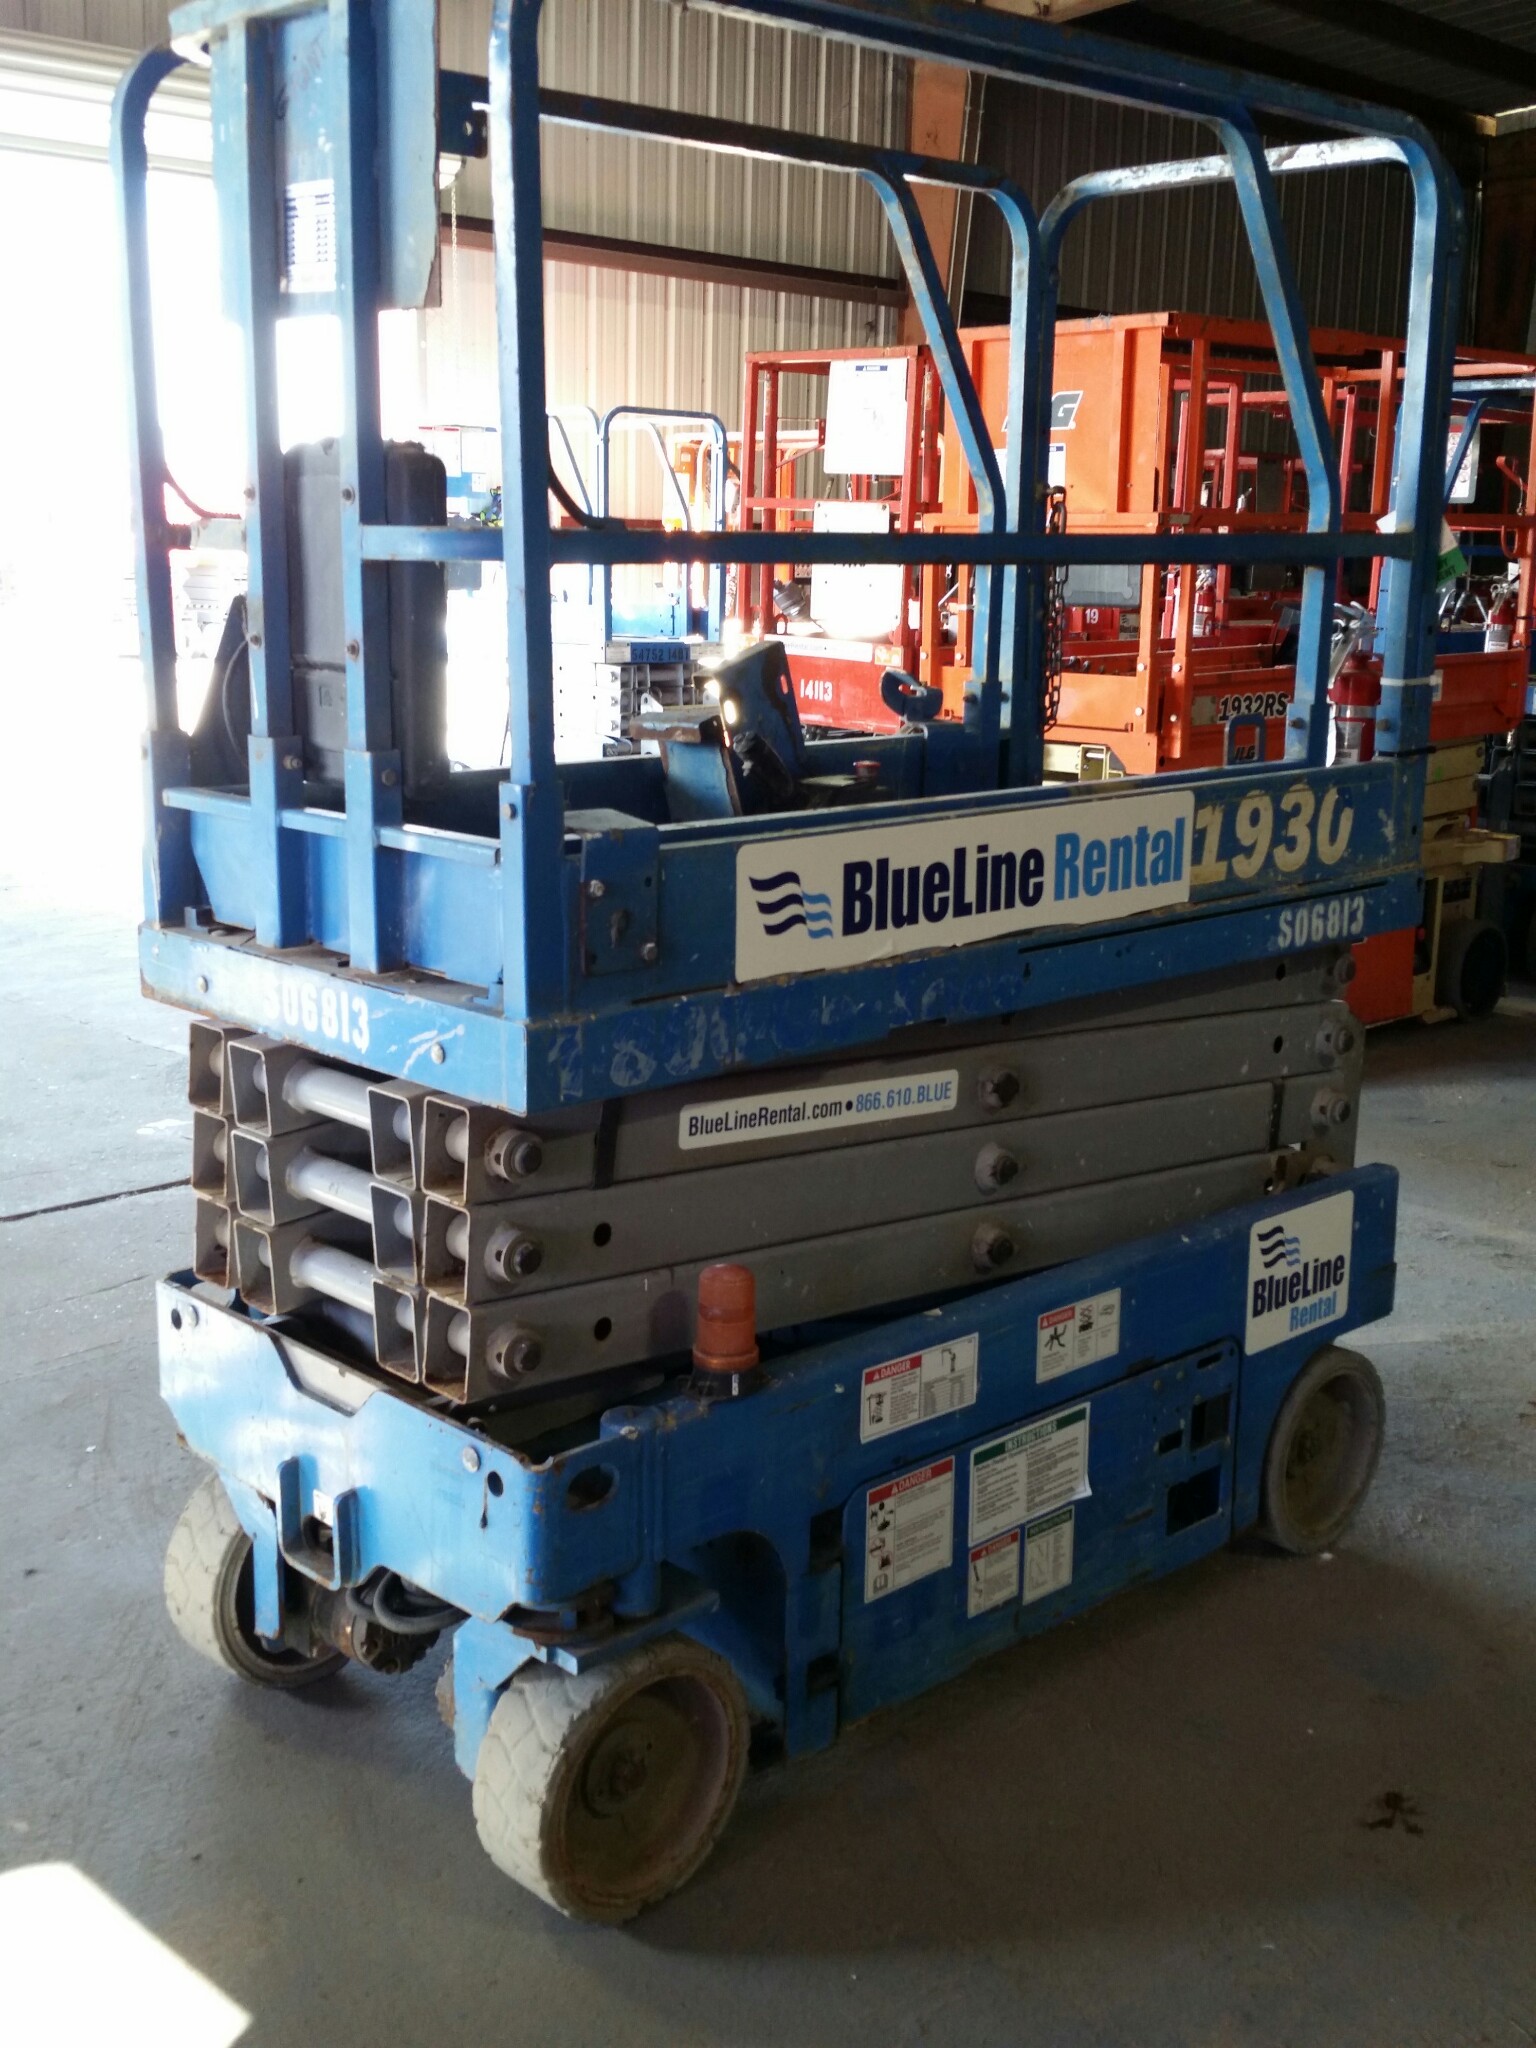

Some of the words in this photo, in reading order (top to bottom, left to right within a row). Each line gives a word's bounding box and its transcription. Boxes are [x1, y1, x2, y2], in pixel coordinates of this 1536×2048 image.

[800, 679, 833, 701] 14113
[1218, 691, 1290, 722] 1932RS
[1189, 783, 1355, 886] 1930
[842, 844, 1045, 937] BlueLine
[1054, 817, 1186, 902] Rental
[688, 1101, 843, 1138] BlueLineRental.com
[856, 1080, 953, 1113] 866.610.BLUE
[1252, 1254, 1346, 1319] BlueLine
[1289, 1291, 1338, 1332] Rental
[880, 1360, 911, 1378] DANGER
[899, 1469, 932, 1491] DANGER
